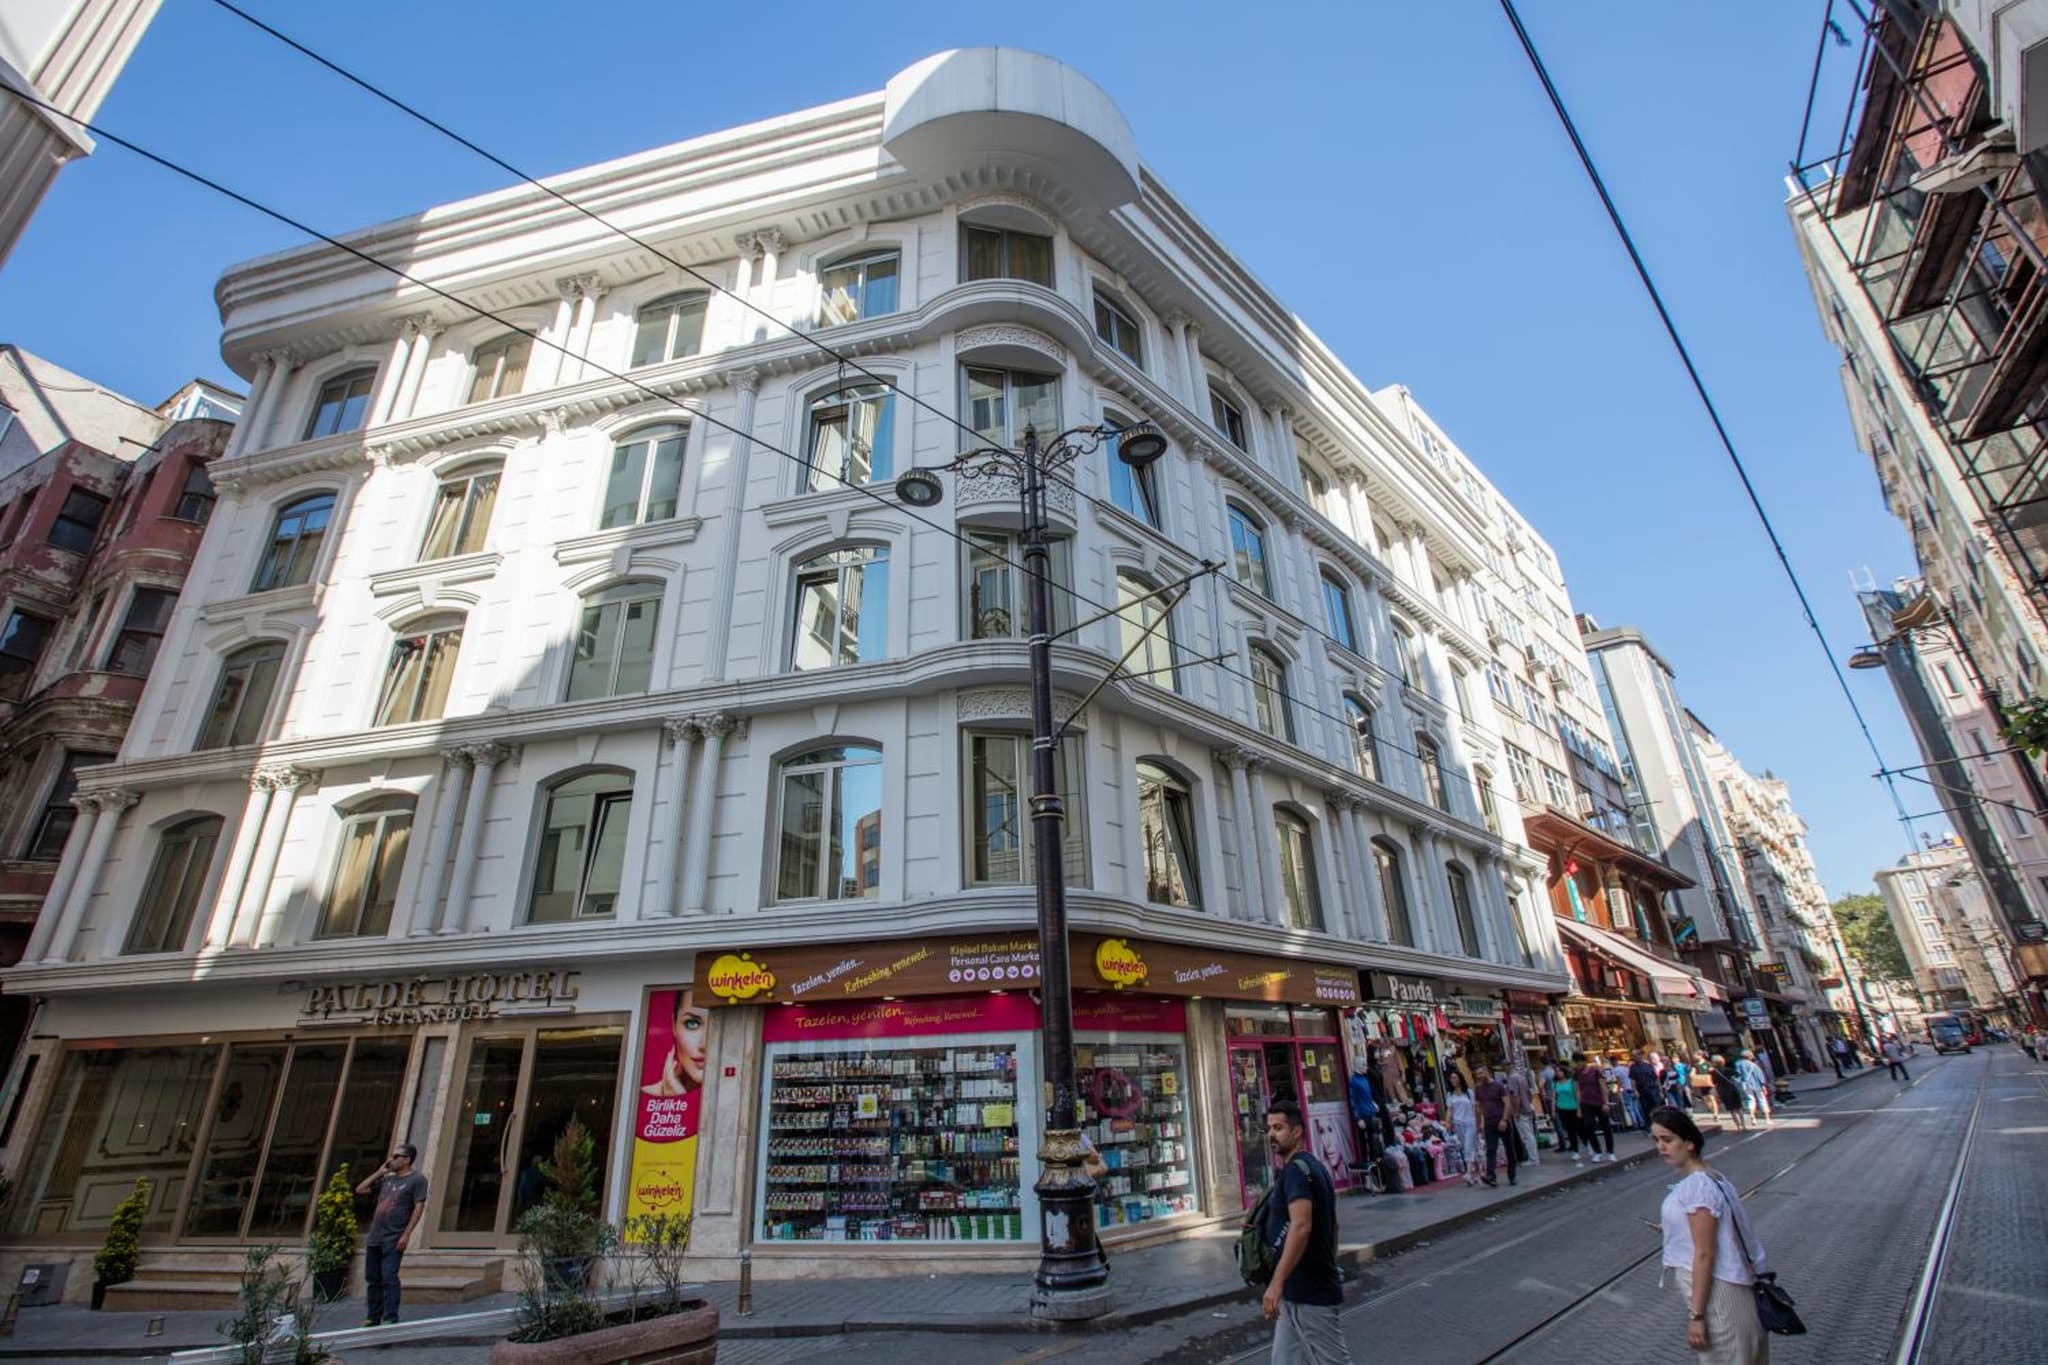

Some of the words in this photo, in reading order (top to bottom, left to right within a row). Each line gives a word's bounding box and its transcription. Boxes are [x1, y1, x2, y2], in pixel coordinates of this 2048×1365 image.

[951, 955, 988, 967] Personal
[989, 954, 1010, 964] Care
[1011, 951, 1041, 962] Marke
[440, 970, 578, 1004] HOTEL
[711, 971, 771, 990] winkelen
[1387, 975, 1435, 1004] Panda
[646, 1099, 688, 1113] Birlikte
[650, 1112, 682, 1125] Daha
[643, 1123, 687, 1137] Güzeliz
[637, 1183, 683, 1200] winkelen
